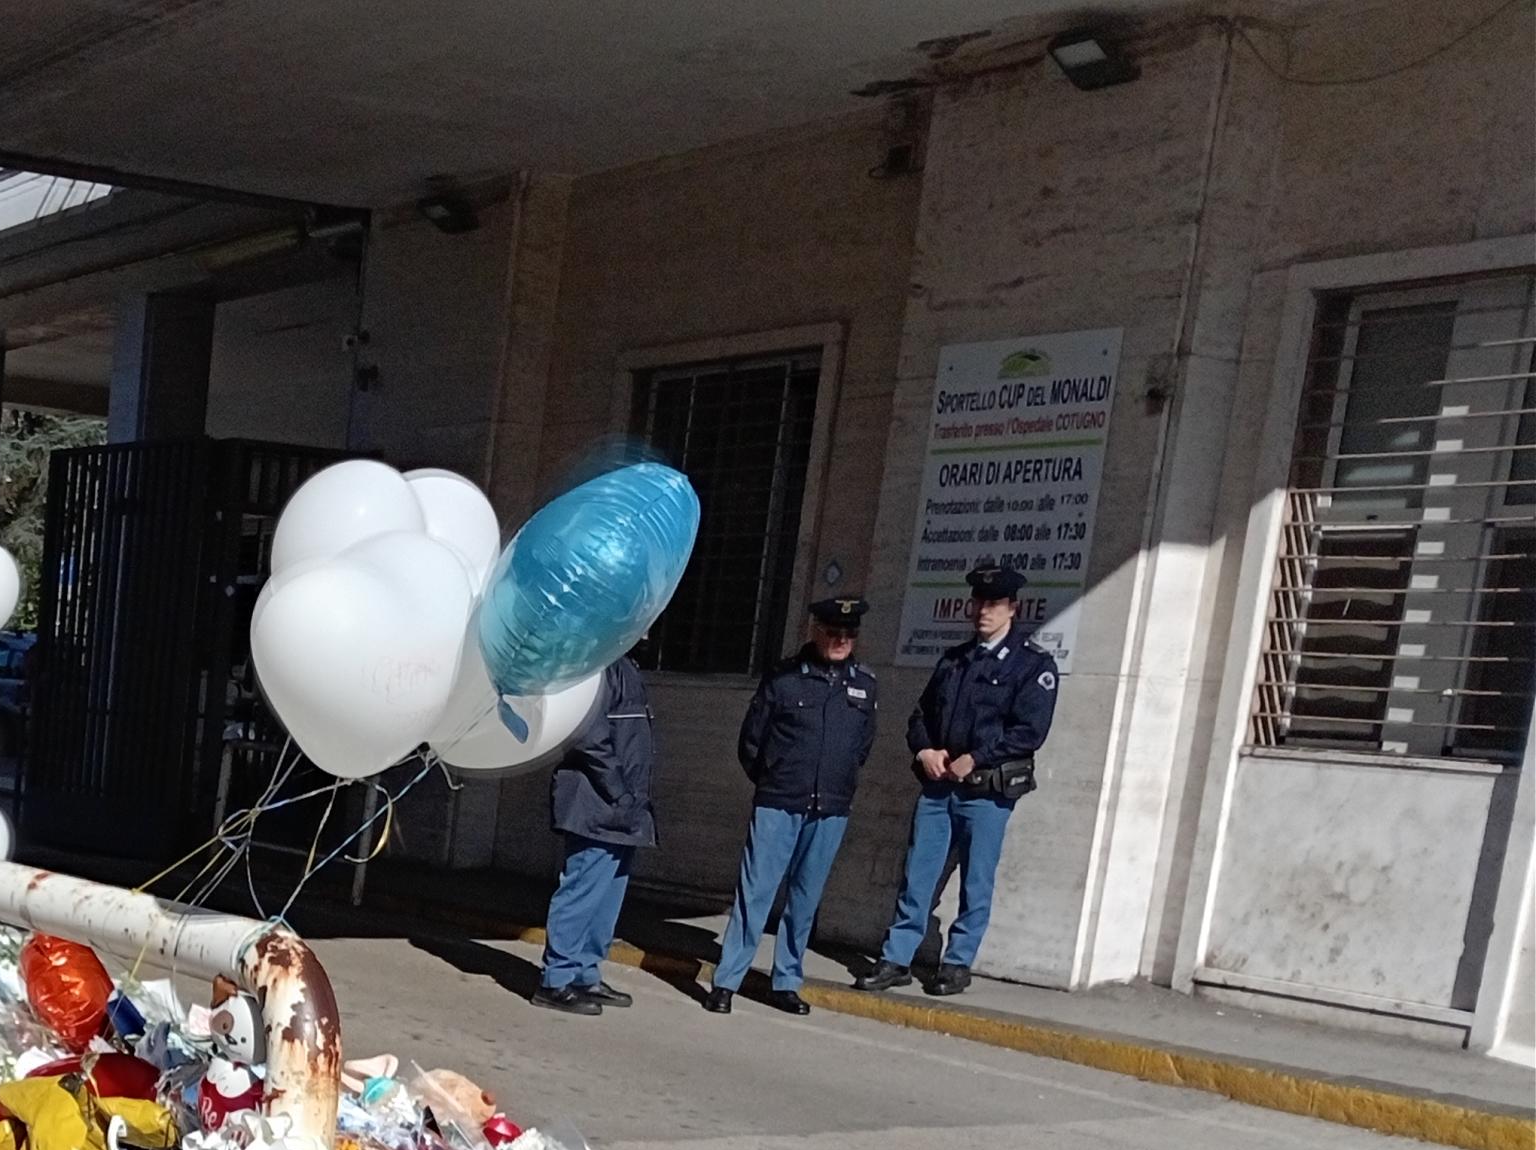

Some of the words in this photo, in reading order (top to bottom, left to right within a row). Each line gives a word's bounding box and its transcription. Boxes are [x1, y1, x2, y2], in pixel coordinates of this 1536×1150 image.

[998, 383, 1025, 409] CUP
[1026, 386, 1046, 408] DEL
[1050, 375, 1112, 405] MONALDI
[1055, 410, 1106, 432] COTUGNO
[939, 462, 984, 487] ORARI
[985, 461, 1002, 485] DI
[1003, 456, 1083, 484] APERTURA
[1004, 523, 1034, 541] 08:00
[1057, 522, 1087, 541] 17:30
[1052, 552, 1082, 570] 17:30
[933, 598, 1047, 620] IMPONTE
